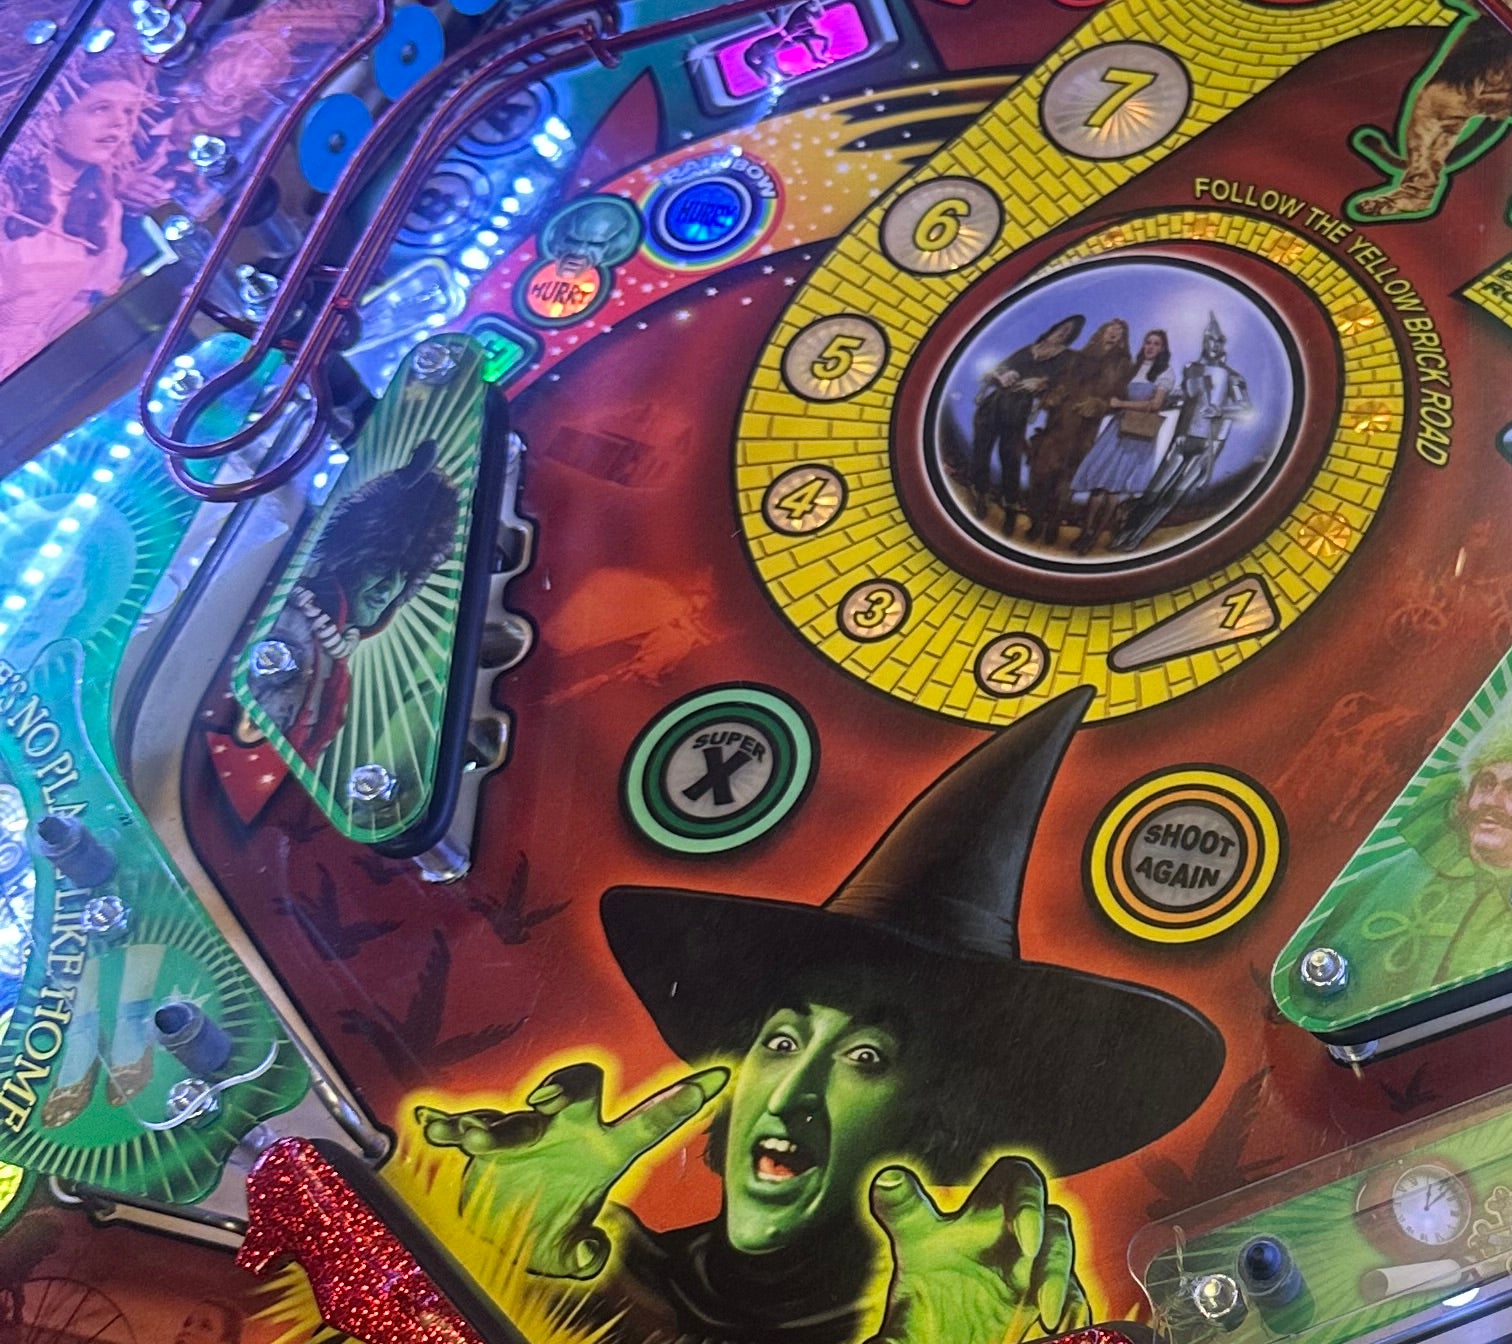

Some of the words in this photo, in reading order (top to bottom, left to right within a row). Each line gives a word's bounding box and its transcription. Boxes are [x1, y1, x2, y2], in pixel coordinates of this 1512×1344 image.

[1084, 68, 1160, 131] 7
[1194, 177, 1306, 220] FOLLOW
[913, 196, 972, 255] 6
[1304, 206, 1353, 243] THE
[531, 282, 594, 306] HURRY
[1346, 235, 1426, 313] YELLOW
[811, 334, 855, 383] 5
[1403, 314, 1452, 389] BRICK
[1415, 387, 1454, 467] ROAD
[777, 476, 830, 519] 4
[853, 588, 897, 630] 3
[1219, 587, 1256, 628] 1
[990, 641, 1035, 686] 2
[692, 731, 766, 763] SUPER
[682, 746, 753, 806] X
[7, 695, 61, 757] NO
[48, 888, 91, 977] LIKE
[1143, 821, 1238, 859] SHOOT
[1135, 856, 1223, 892] AGAIN
